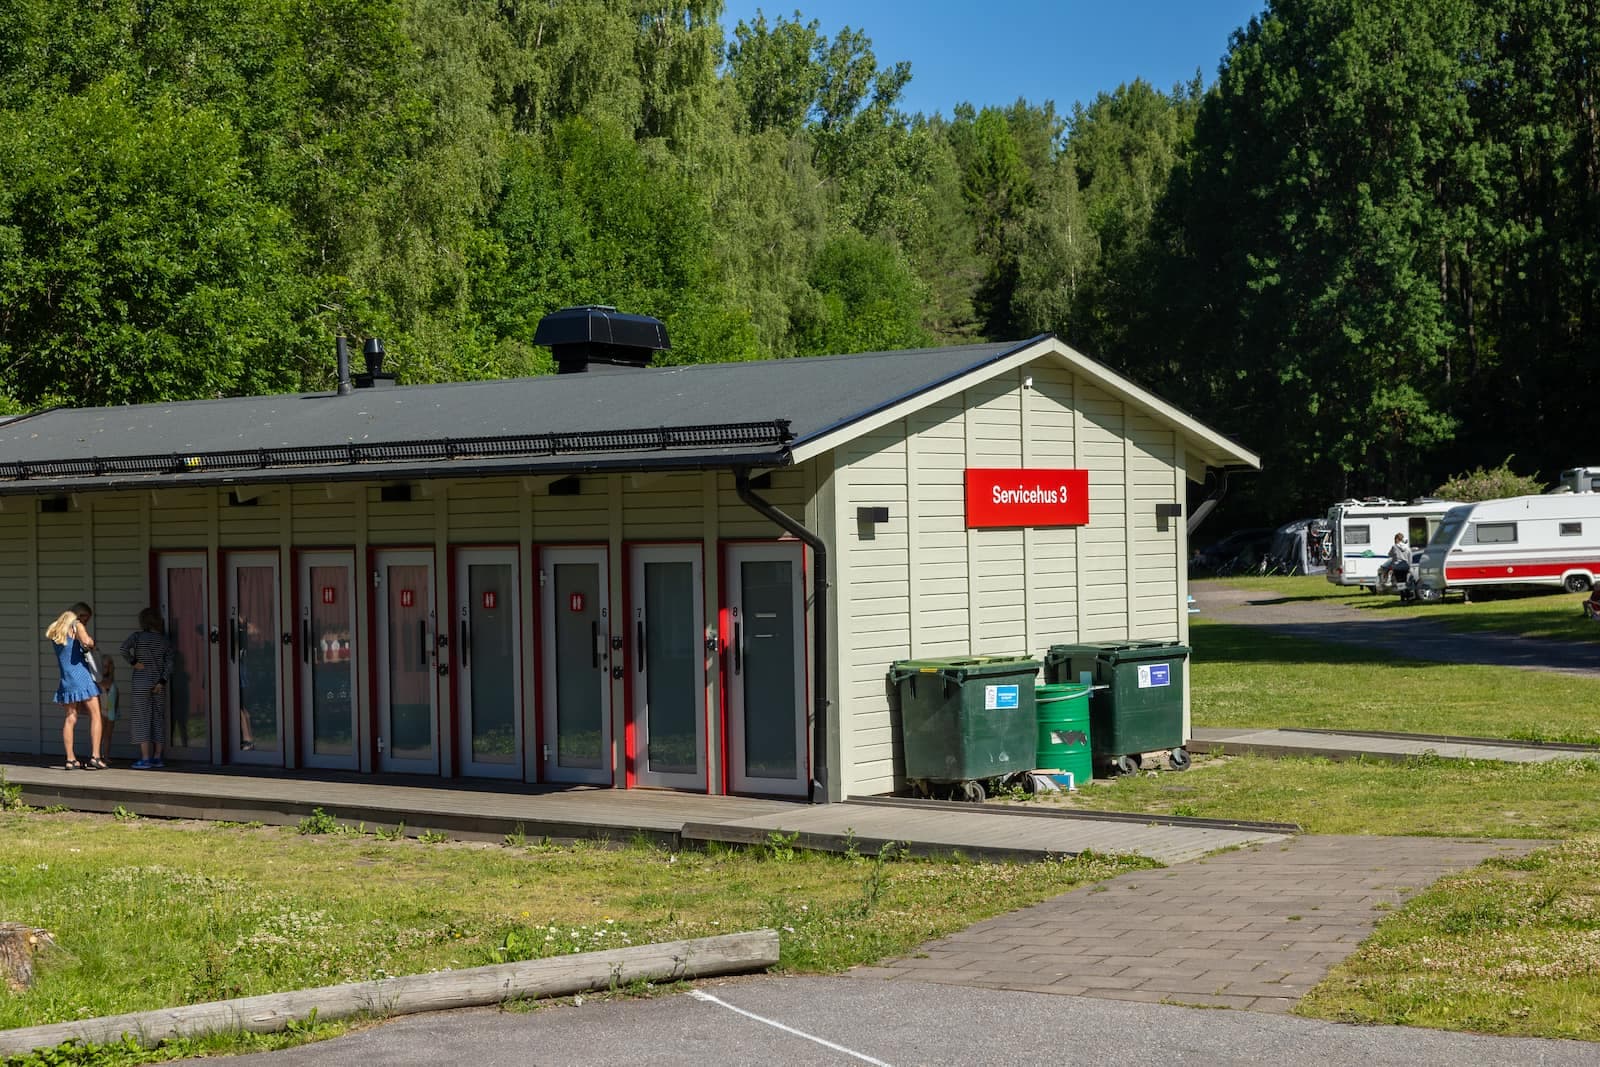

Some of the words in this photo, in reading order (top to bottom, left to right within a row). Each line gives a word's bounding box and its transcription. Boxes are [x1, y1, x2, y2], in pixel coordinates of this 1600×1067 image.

[992, 485, 1057, 504] Servicehus
[1059, 485, 1067, 503] 3
[232, 606, 237, 615] 2
[304, 606, 309, 616] 3
[430, 609, 435, 618] 4
[462, 606, 467, 616] 5
[602, 607, 607, 617] 6
[636, 608, 642, 618] 7
[733, 606, 738, 617] 8
